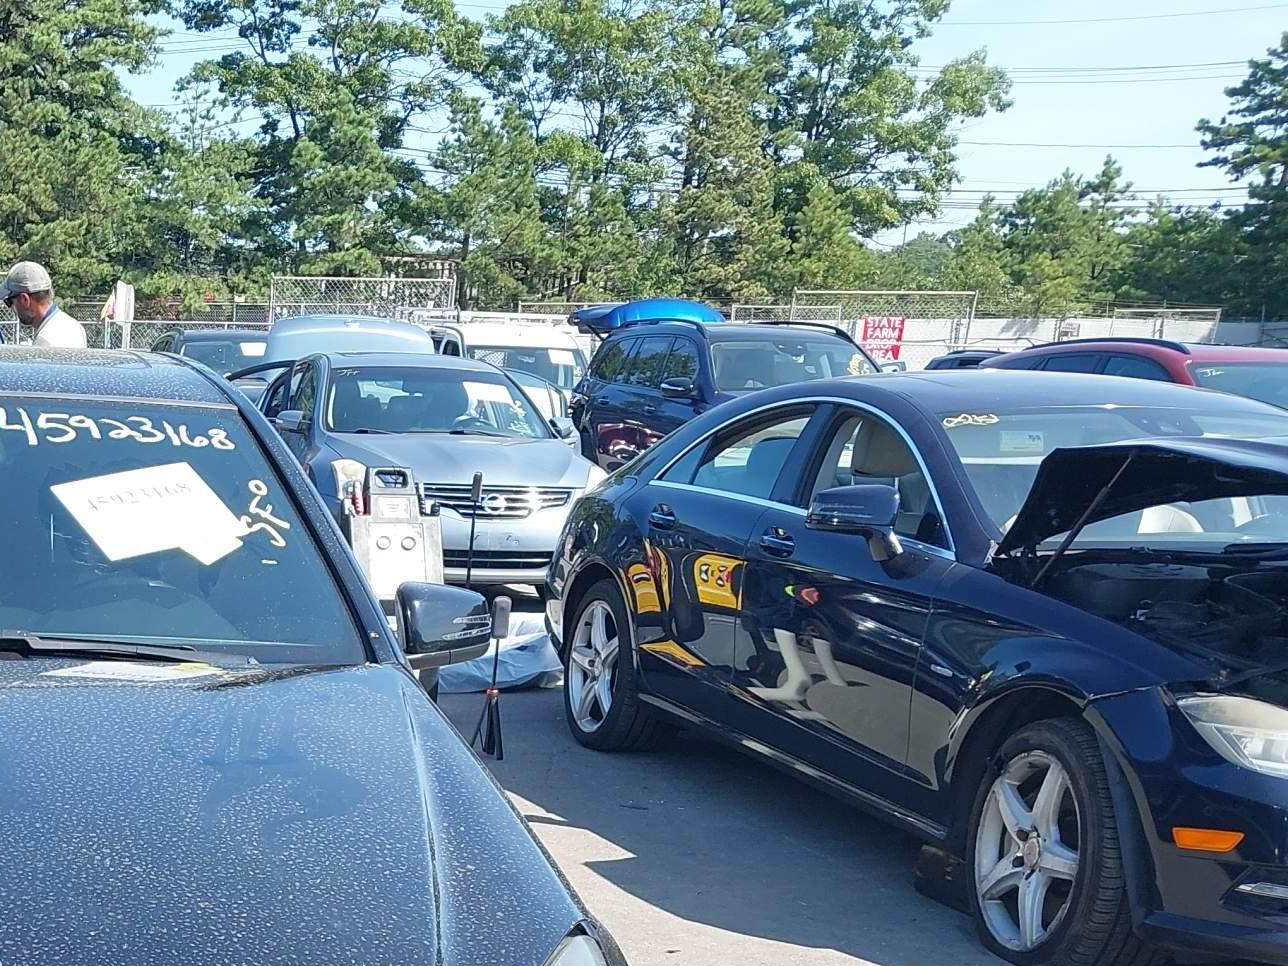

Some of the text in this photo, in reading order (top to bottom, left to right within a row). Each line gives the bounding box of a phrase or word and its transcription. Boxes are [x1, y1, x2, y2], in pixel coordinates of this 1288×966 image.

[867, 316, 902, 327] STATE
[867, 328, 900, 338] FARM
[865, 339, 897, 349] DROP
